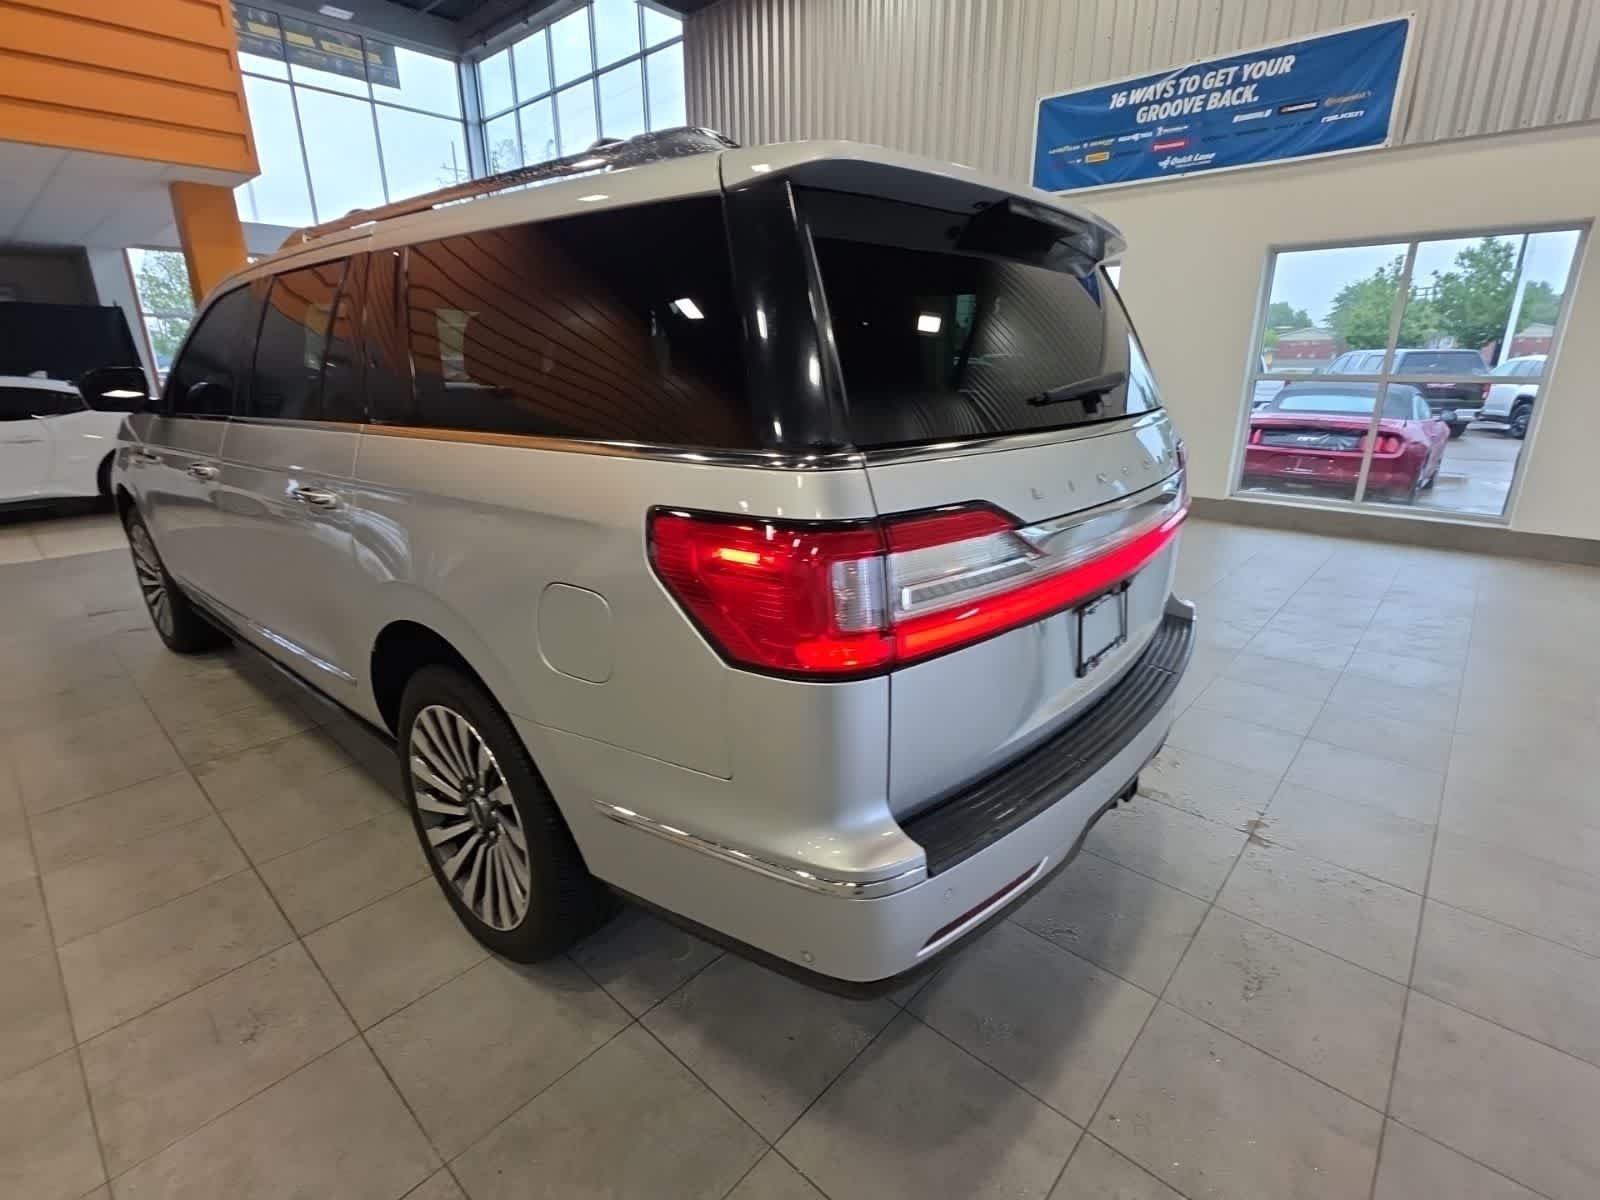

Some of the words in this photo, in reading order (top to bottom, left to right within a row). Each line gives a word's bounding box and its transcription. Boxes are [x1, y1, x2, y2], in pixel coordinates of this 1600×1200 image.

[1109, 91, 1127, 110] 16
[1128, 79, 1174, 105] WAYS
[1178, 74, 1200, 95] TO
[1202, 66, 1240, 90] GET
[1241, 55, 1296, 82] YOUR
[1136, 94, 1203, 124] GROOVE
[1206, 83, 1260, 111] BACK.
